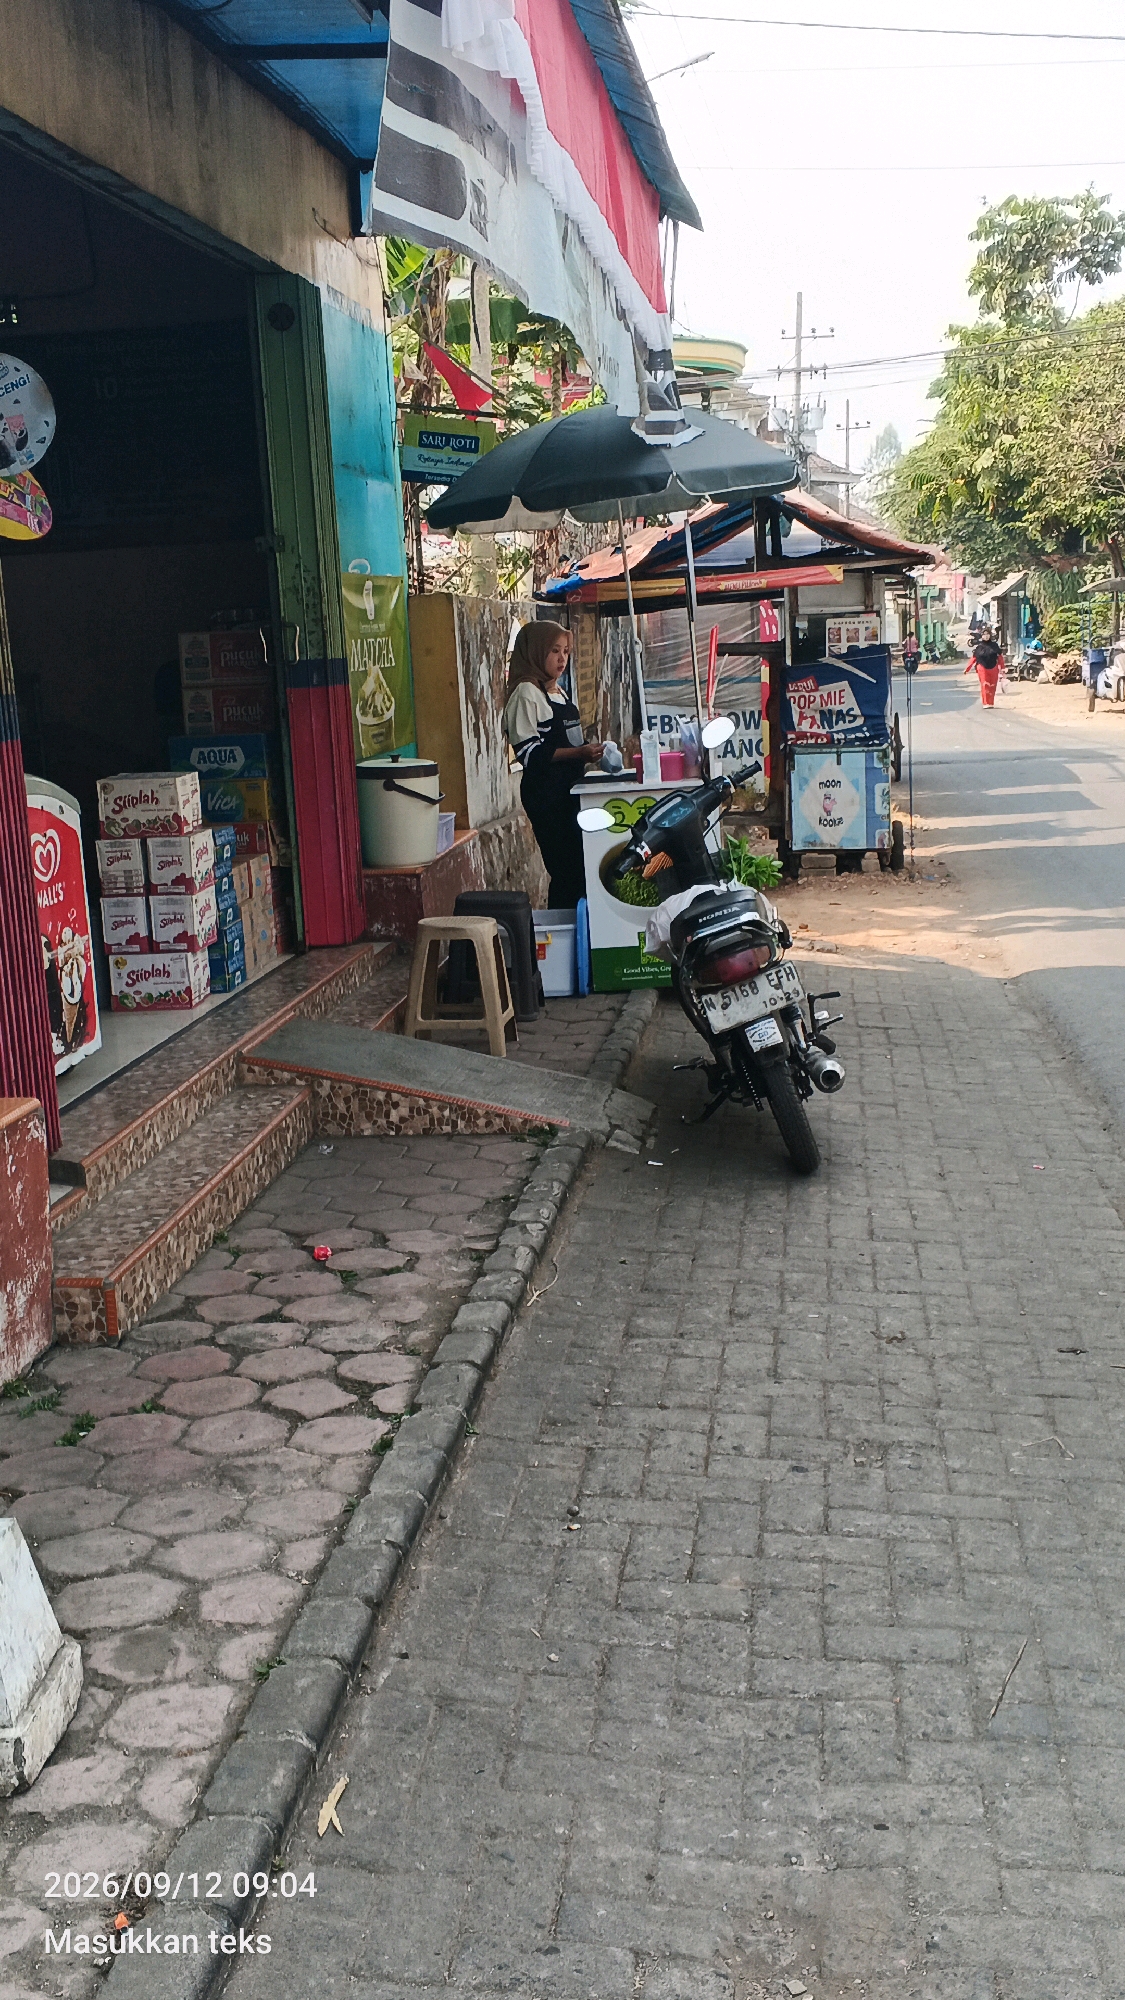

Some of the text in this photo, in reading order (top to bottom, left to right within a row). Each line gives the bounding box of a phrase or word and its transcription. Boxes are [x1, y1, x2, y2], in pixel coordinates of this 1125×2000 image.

[421, 434, 476, 450] SARI ROTI
[350, 636, 396, 672] MATCHA
[788, 689, 846, 710] POP MIE
[197, 748, 238, 766] AQUA
[818, 779, 842, 790] moon
[111, 789, 160, 815] Siiplah
[37, 882, 64, 908] WALL'S
[698, 906, 741, 923] HONDA
[125, 962, 171, 988] Siiplah
[703, 966, 796, 1012] N 5168 EFH
